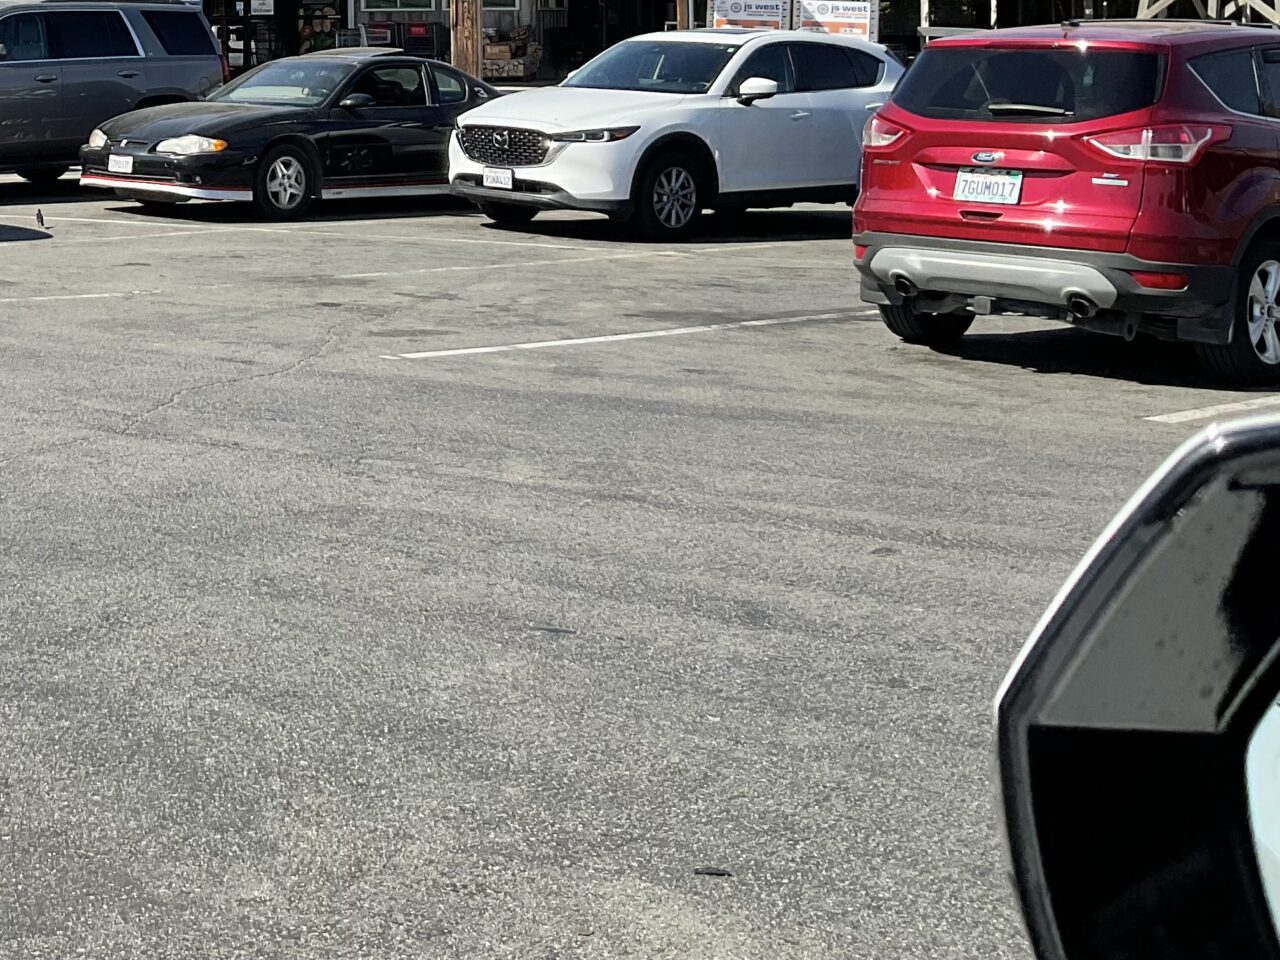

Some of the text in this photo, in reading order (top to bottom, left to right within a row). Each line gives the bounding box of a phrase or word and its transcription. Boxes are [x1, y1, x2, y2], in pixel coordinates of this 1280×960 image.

[744, 2, 752, 11] js
[831, 3, 839, 13] js
[474, 87, 488, 98] 3
[962, 179, 1016, 197] 7GUM017
